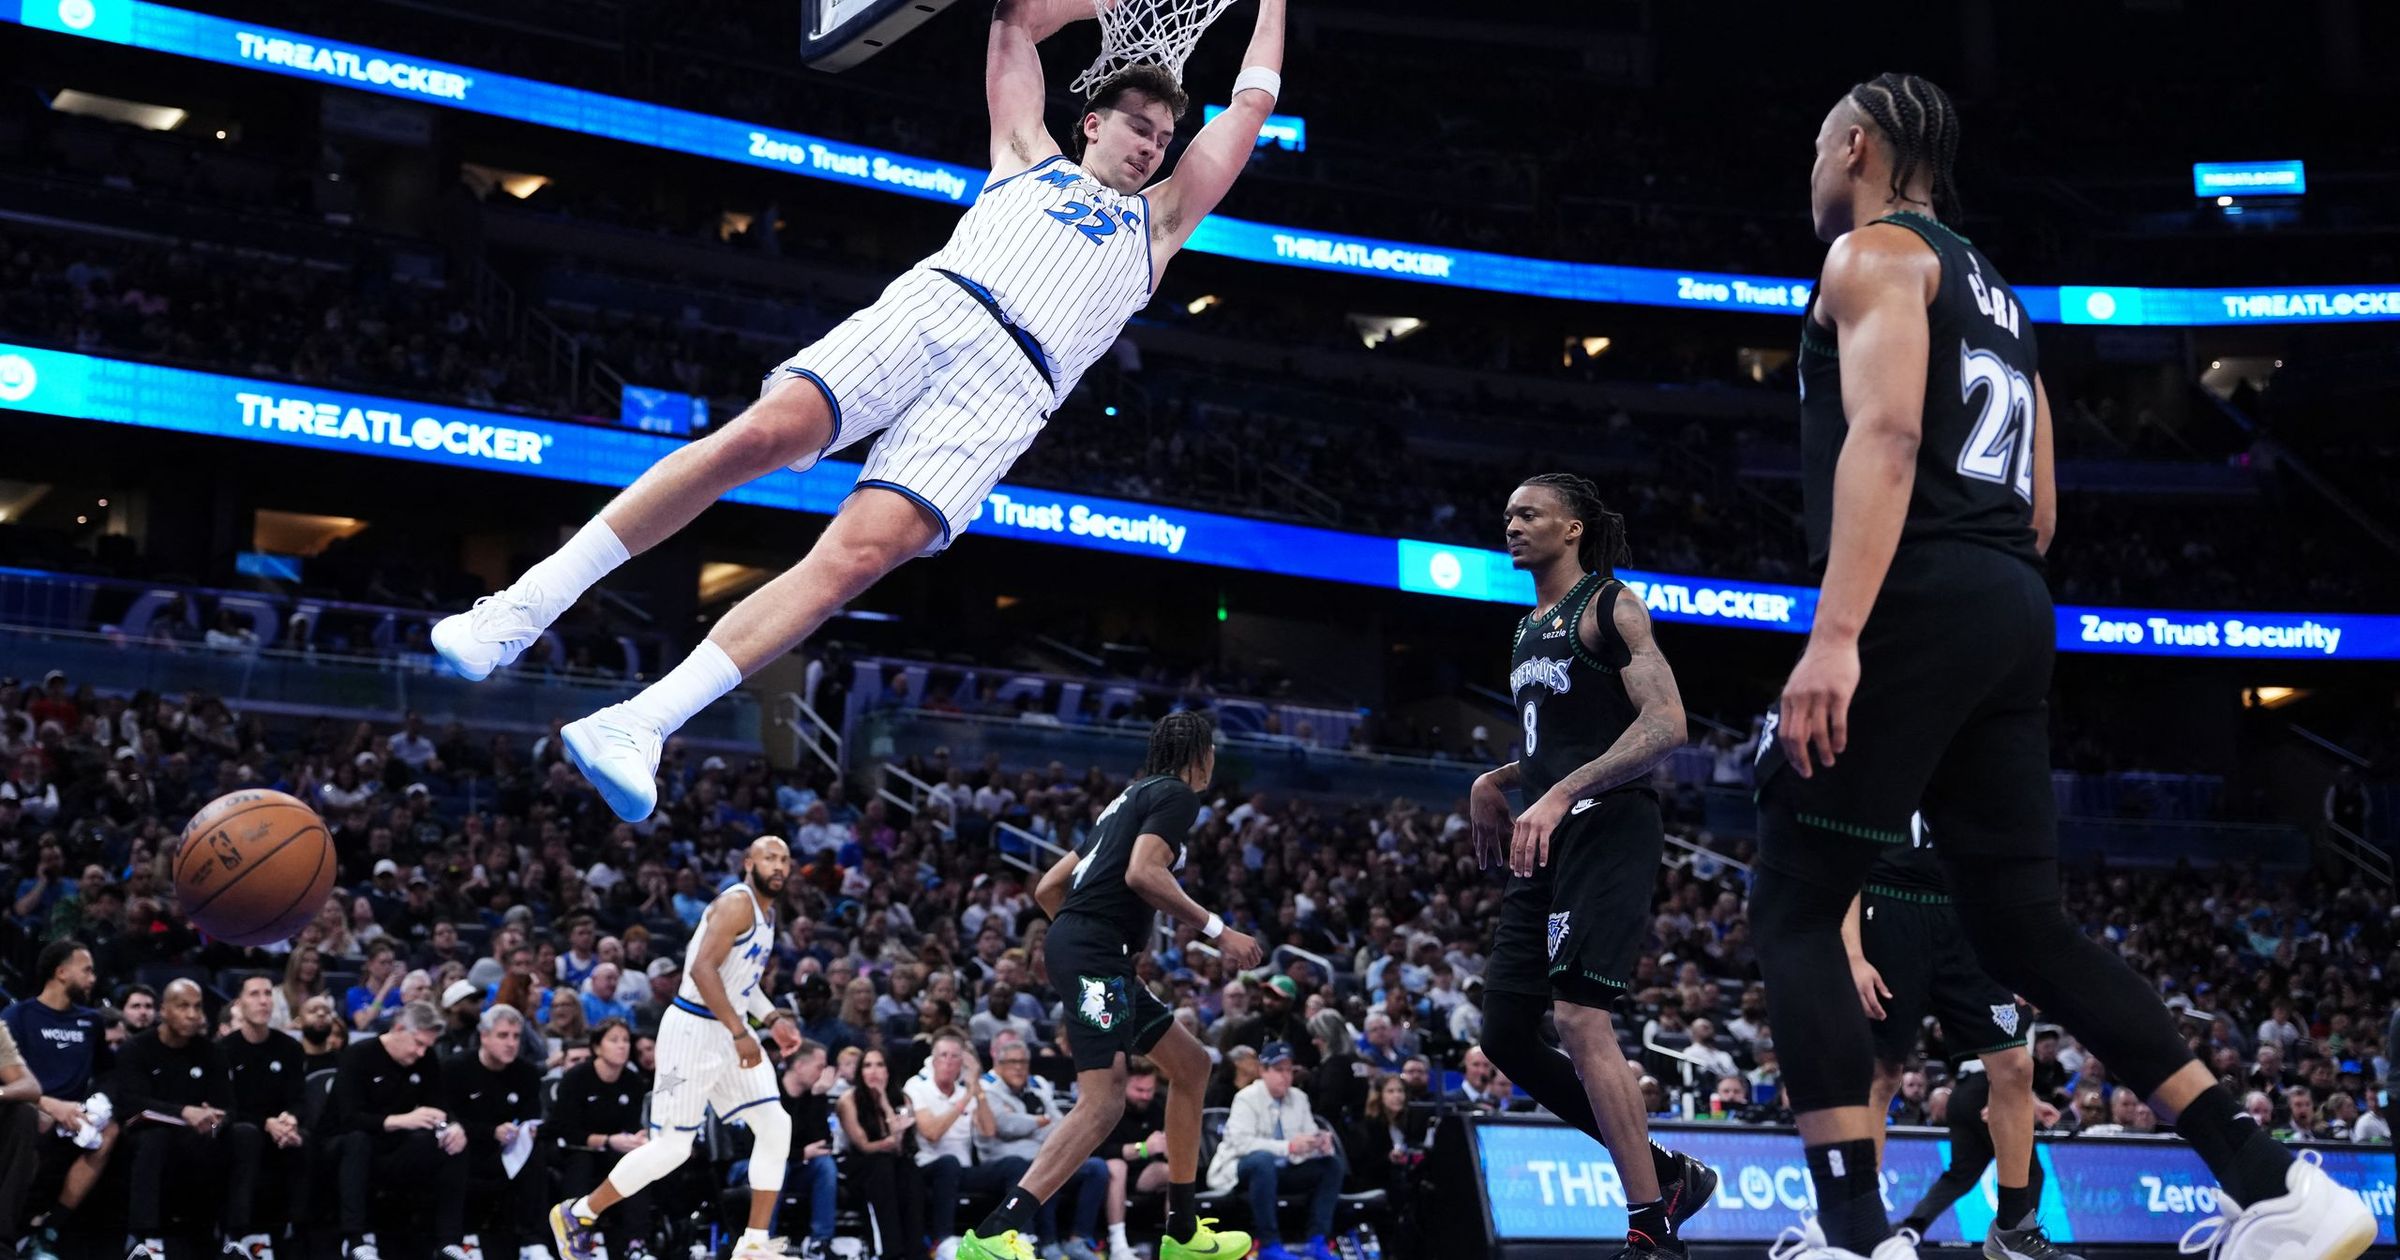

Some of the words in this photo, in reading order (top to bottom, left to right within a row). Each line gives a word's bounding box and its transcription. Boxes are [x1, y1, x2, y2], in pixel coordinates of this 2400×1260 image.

[236, 32, 466, 100] THREATLOCKER
[749, 132, 805, 165] Zero
[809, 144, 869, 178] Trust
[873, 157, 967, 200] Security
[1044, 201, 1117, 246] 22
[1273, 234, 1449, 277] THREATLOCKER
[1678, 277, 1730, 302] Zero
[1732, 281, 1788, 306] Trust
[2222, 292, 2400, 317] THREATLOCKE
[236, 393, 543, 465] THREATLOCKER
[1956, 337, 2034, 506] 22
[988, 493, 1064, 532] Trust
[1069, 504, 1187, 554] Security
[1622, 579, 1791, 623] EATLOCKER
[1542, 628, 1567, 640] sezzle
[2080, 614, 2144, 644] Zero
[2147, 617, 2220, 647] Trust
[2224, 620, 2341, 654] Security
[1523, 701, 1537, 757] 8
[41, 1028, 84, 1042] WOLVES
[2140, 1176, 2216, 1214] Zero
